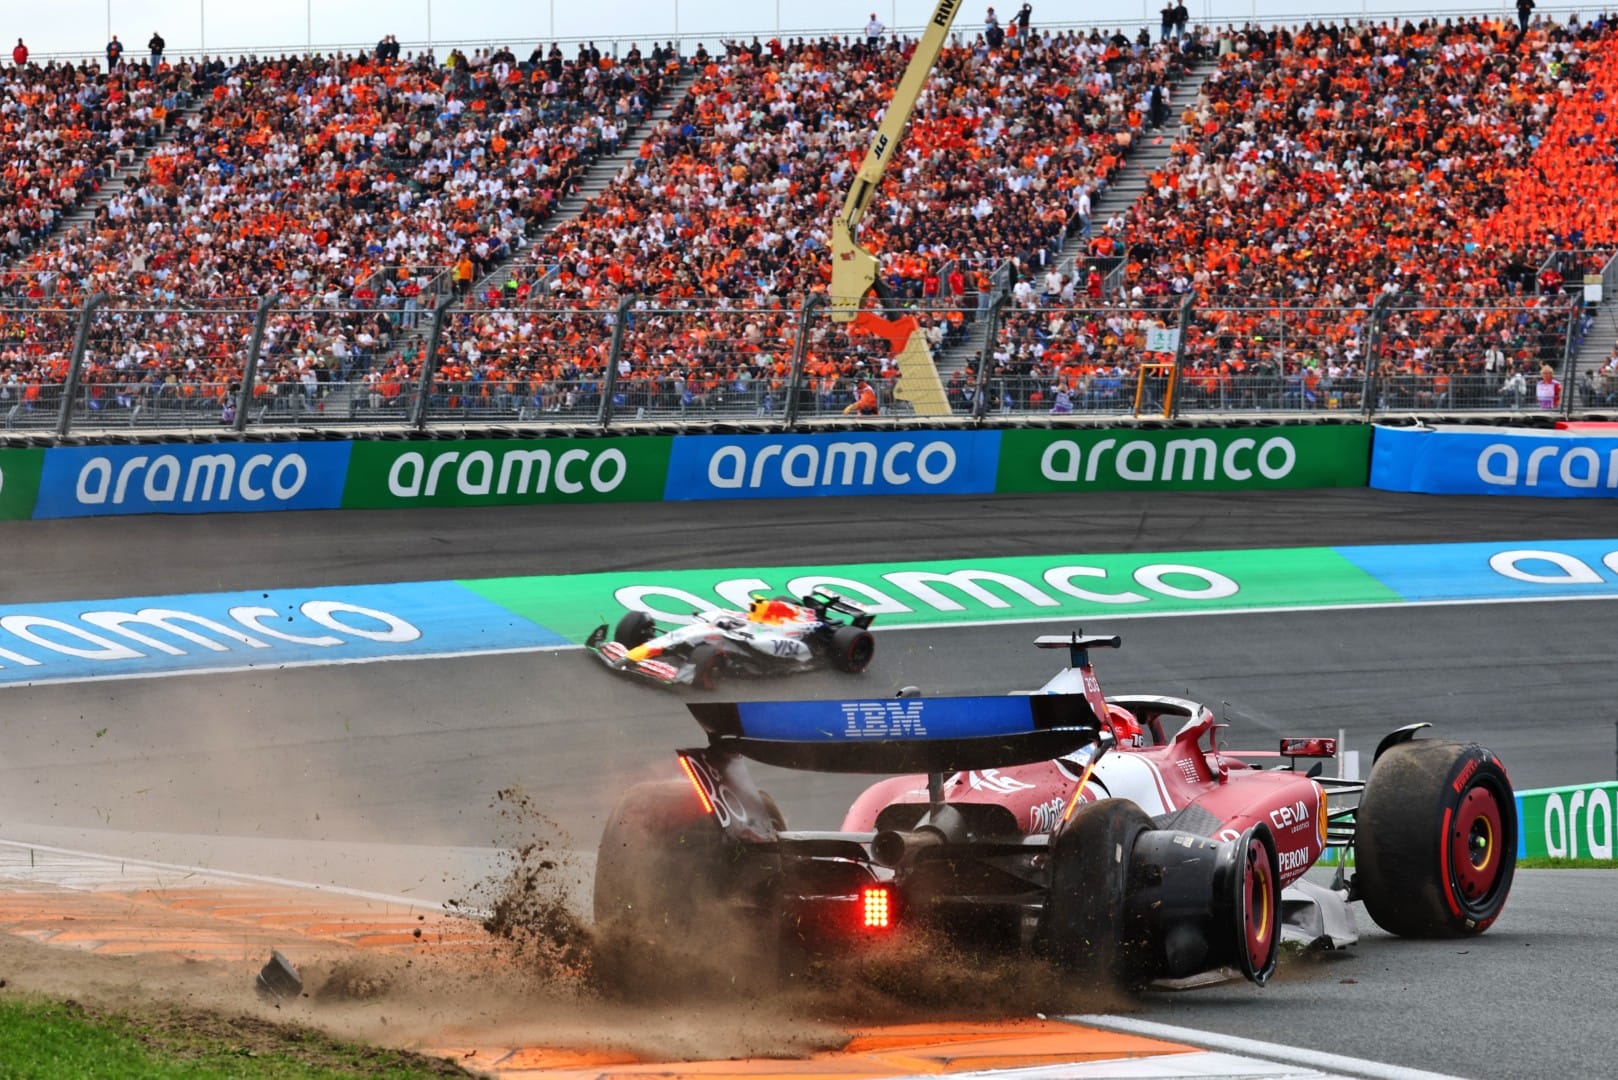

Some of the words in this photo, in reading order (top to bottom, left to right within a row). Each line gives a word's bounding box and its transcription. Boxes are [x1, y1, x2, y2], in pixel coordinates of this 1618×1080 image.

[873, 134, 888, 160] JLG
[77, 455, 307, 504] aramco
[388, 448, 627, 497] aramco
[709, 441, 956, 488] aramco
[1041, 437, 1296, 482] aramco
[0, 600, 422, 668] amco
[841, 701, 927, 737] IBM
[1544, 787, 1618, 860] ara
[1279, 846, 1310, 873] PERONI
